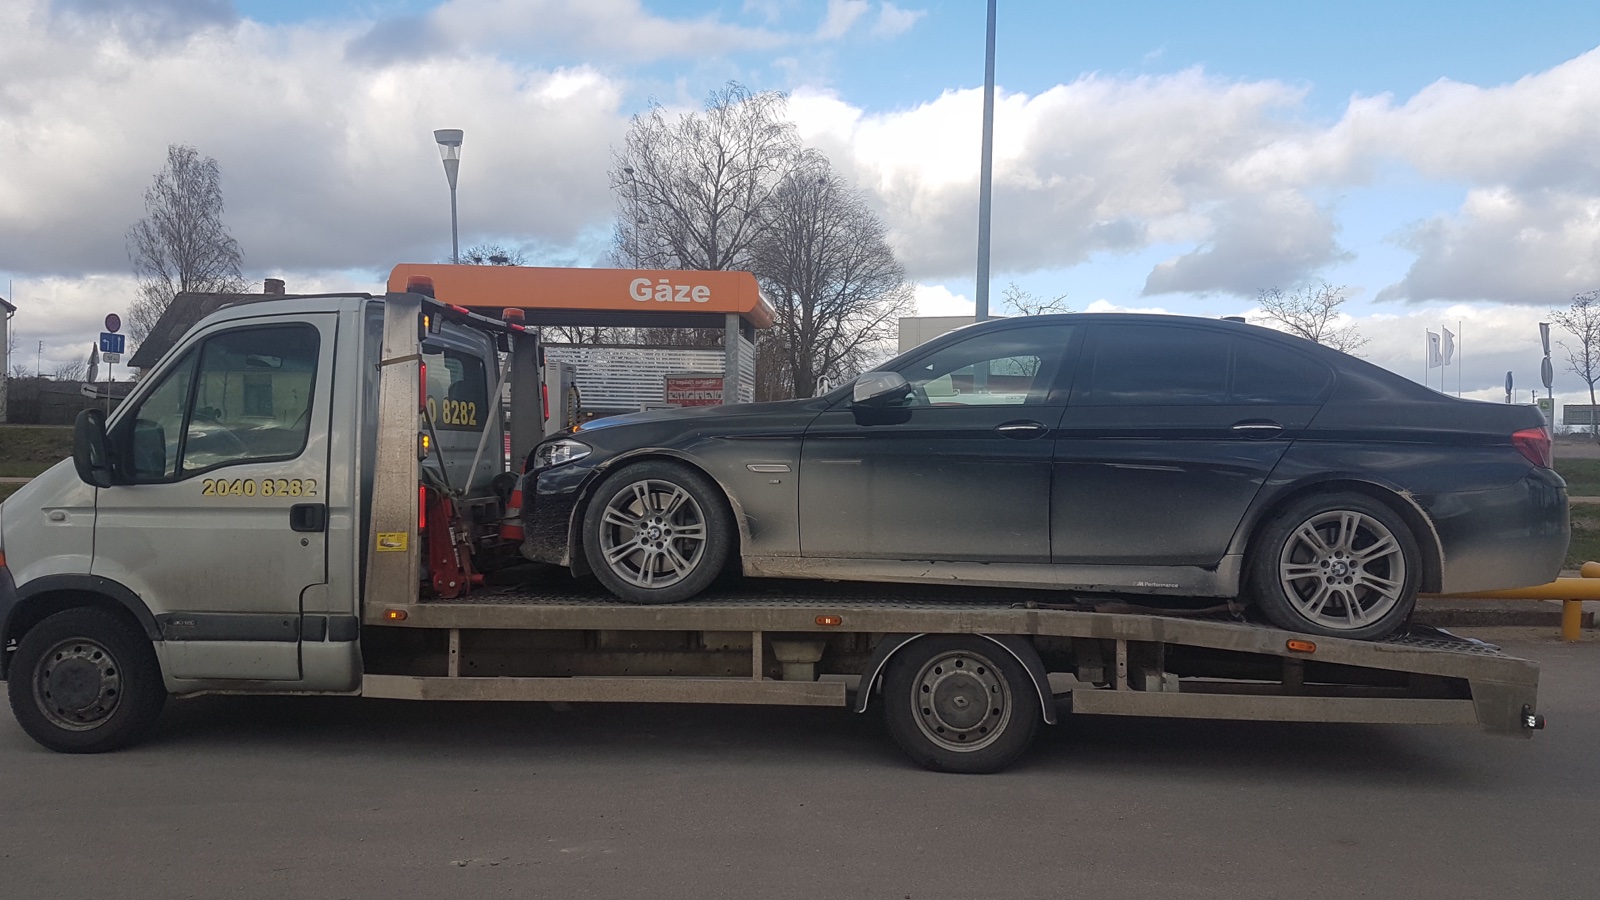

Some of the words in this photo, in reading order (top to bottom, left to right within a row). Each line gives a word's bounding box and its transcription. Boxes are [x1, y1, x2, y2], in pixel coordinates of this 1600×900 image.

[629, 277, 711, 303] Gāze
[443, 397, 477, 426] 8282
[202, 478, 257, 497] 2040
[261, 478, 317, 497] 8282
